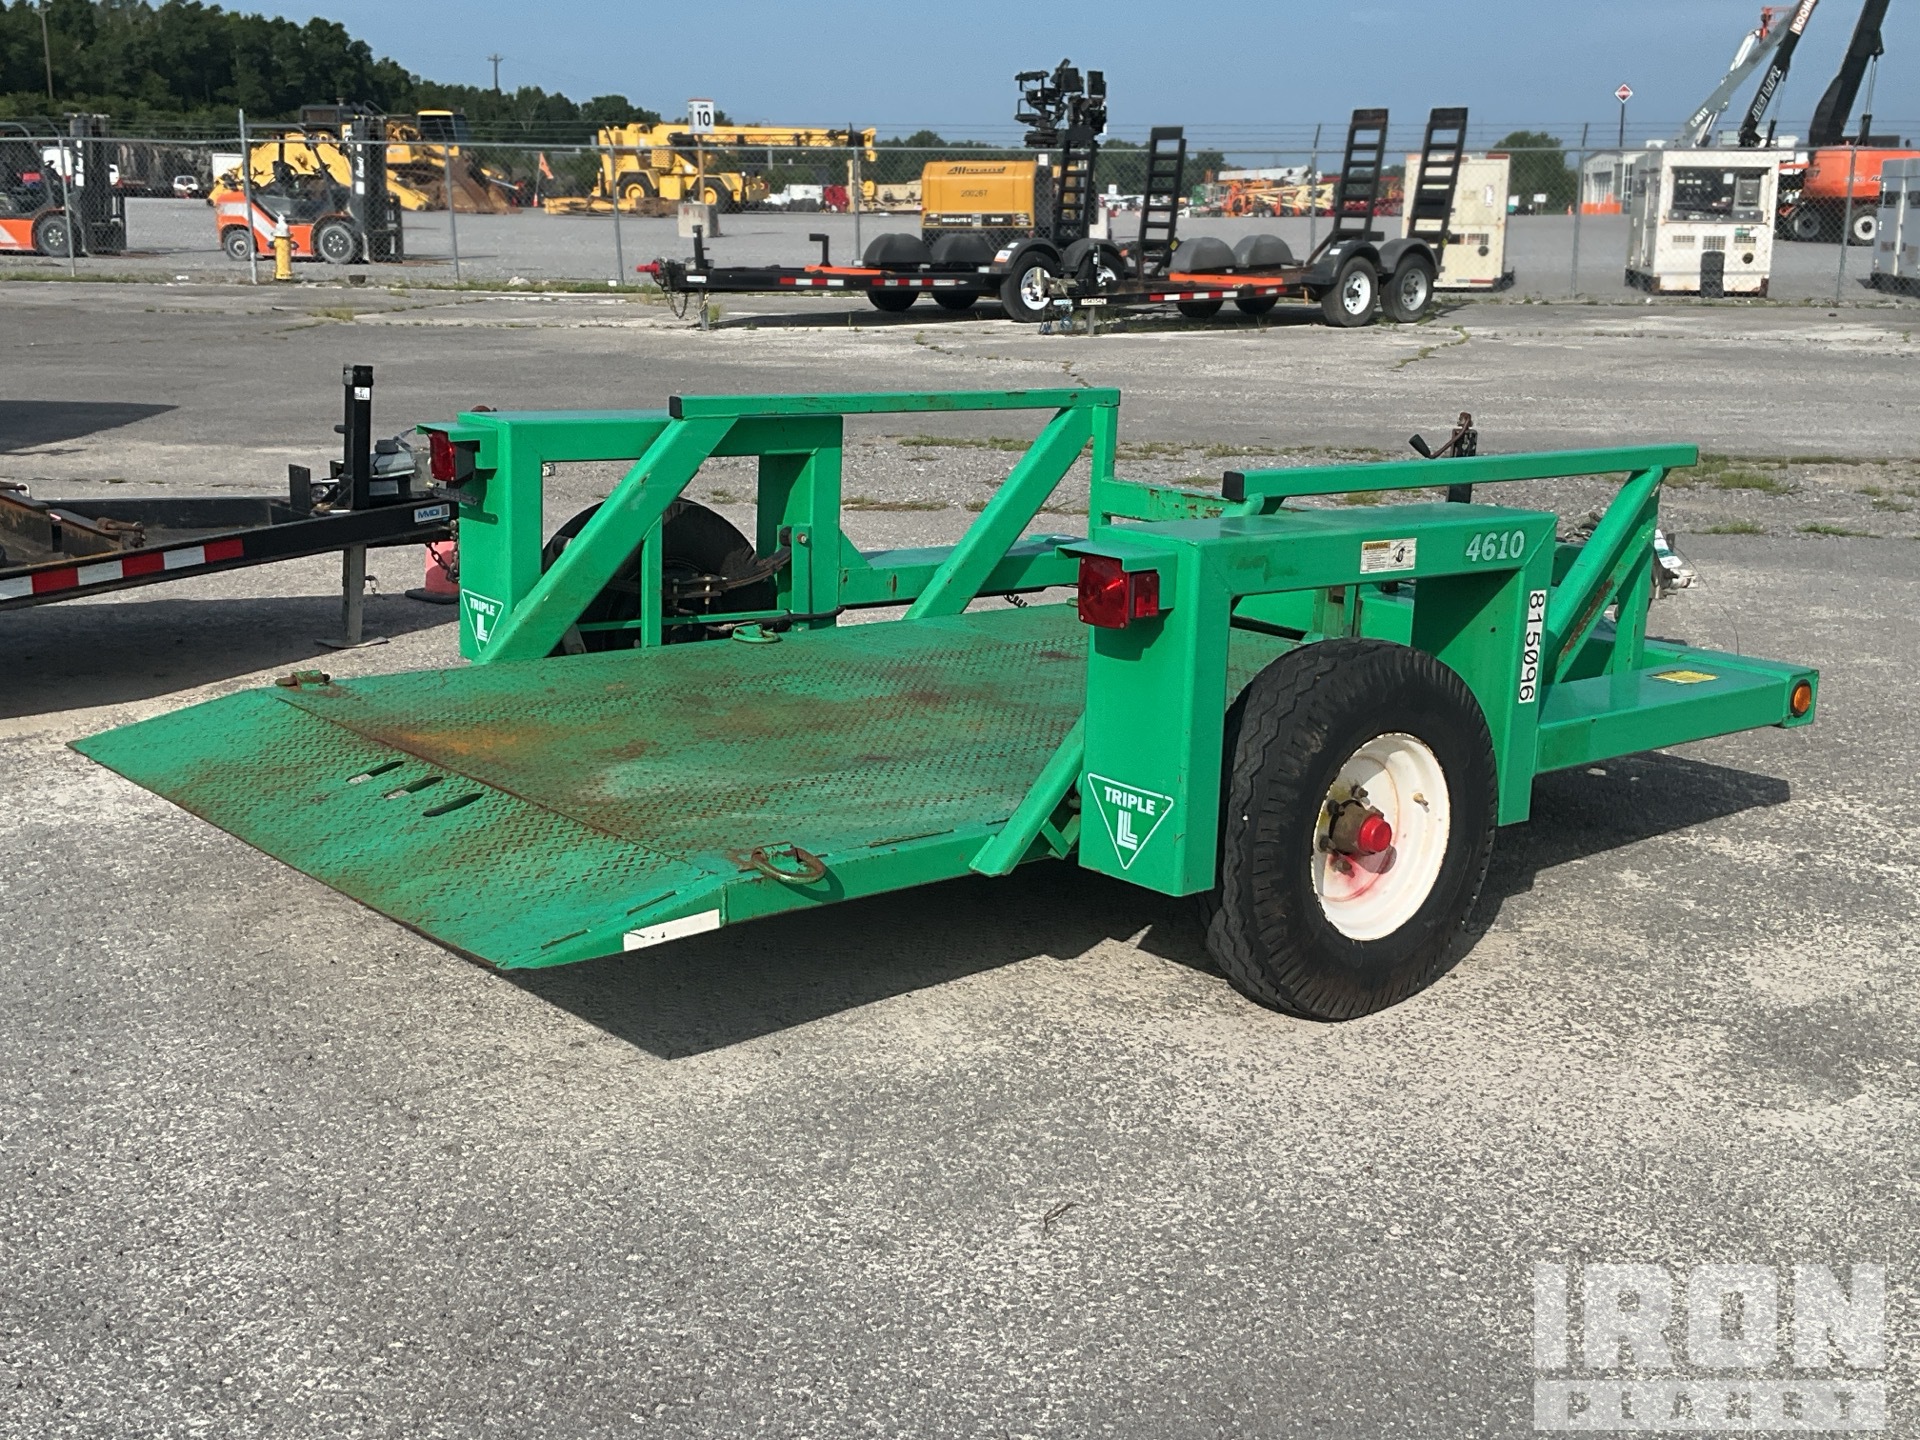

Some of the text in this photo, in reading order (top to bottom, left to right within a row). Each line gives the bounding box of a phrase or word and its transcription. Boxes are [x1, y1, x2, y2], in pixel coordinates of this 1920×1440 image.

[1751, 65, 1781, 122] JLG LIFT
[697, 111, 711, 126] 10
[947, 166, 1006, 175] Allmand
[1465, 530, 1525, 562] 4610
[470, 597, 495, 616] TRIPLE
[1519, 592, 1545, 701] 815096
[1104, 786, 1156, 816] TRIPLE
